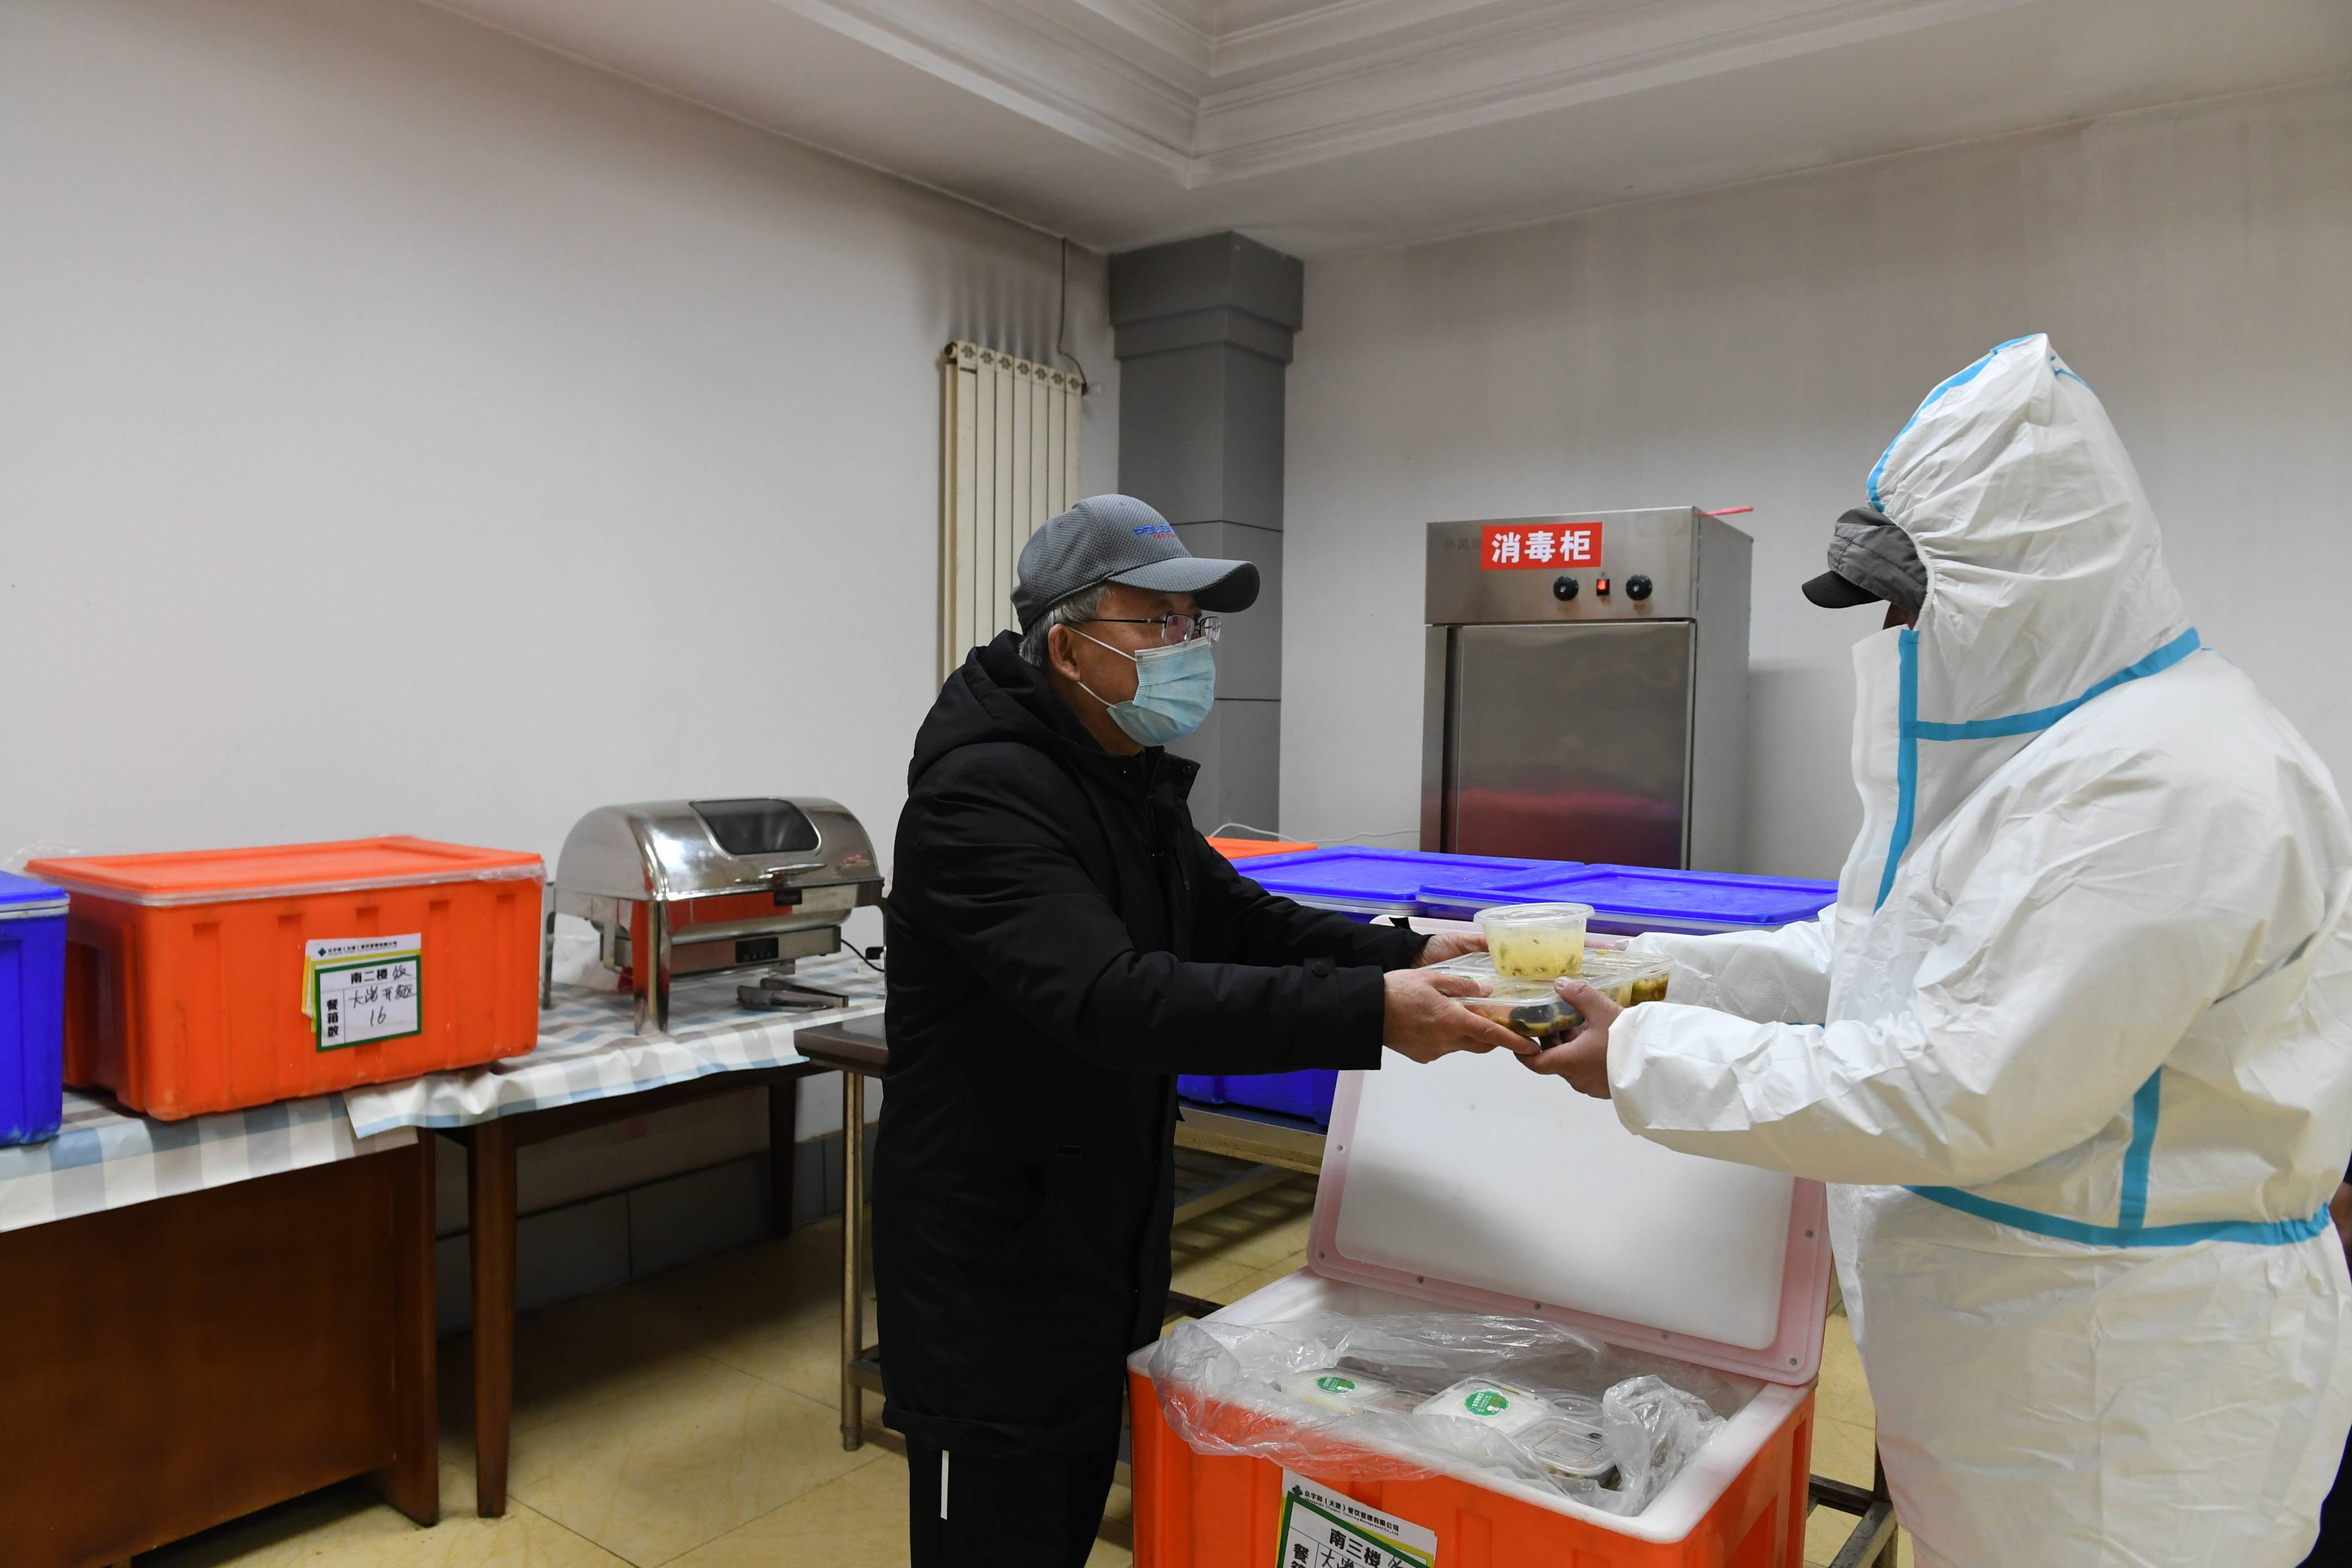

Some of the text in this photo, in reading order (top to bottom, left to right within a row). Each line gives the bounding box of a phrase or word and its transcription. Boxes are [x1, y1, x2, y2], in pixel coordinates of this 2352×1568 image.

[1491, 530, 1591, 563] 消毒柜
[351, 968, 387, 985] 南二楼
[370, 1006, 386, 1026] 16
[1330, 1528, 1381, 1568] 南三楼
